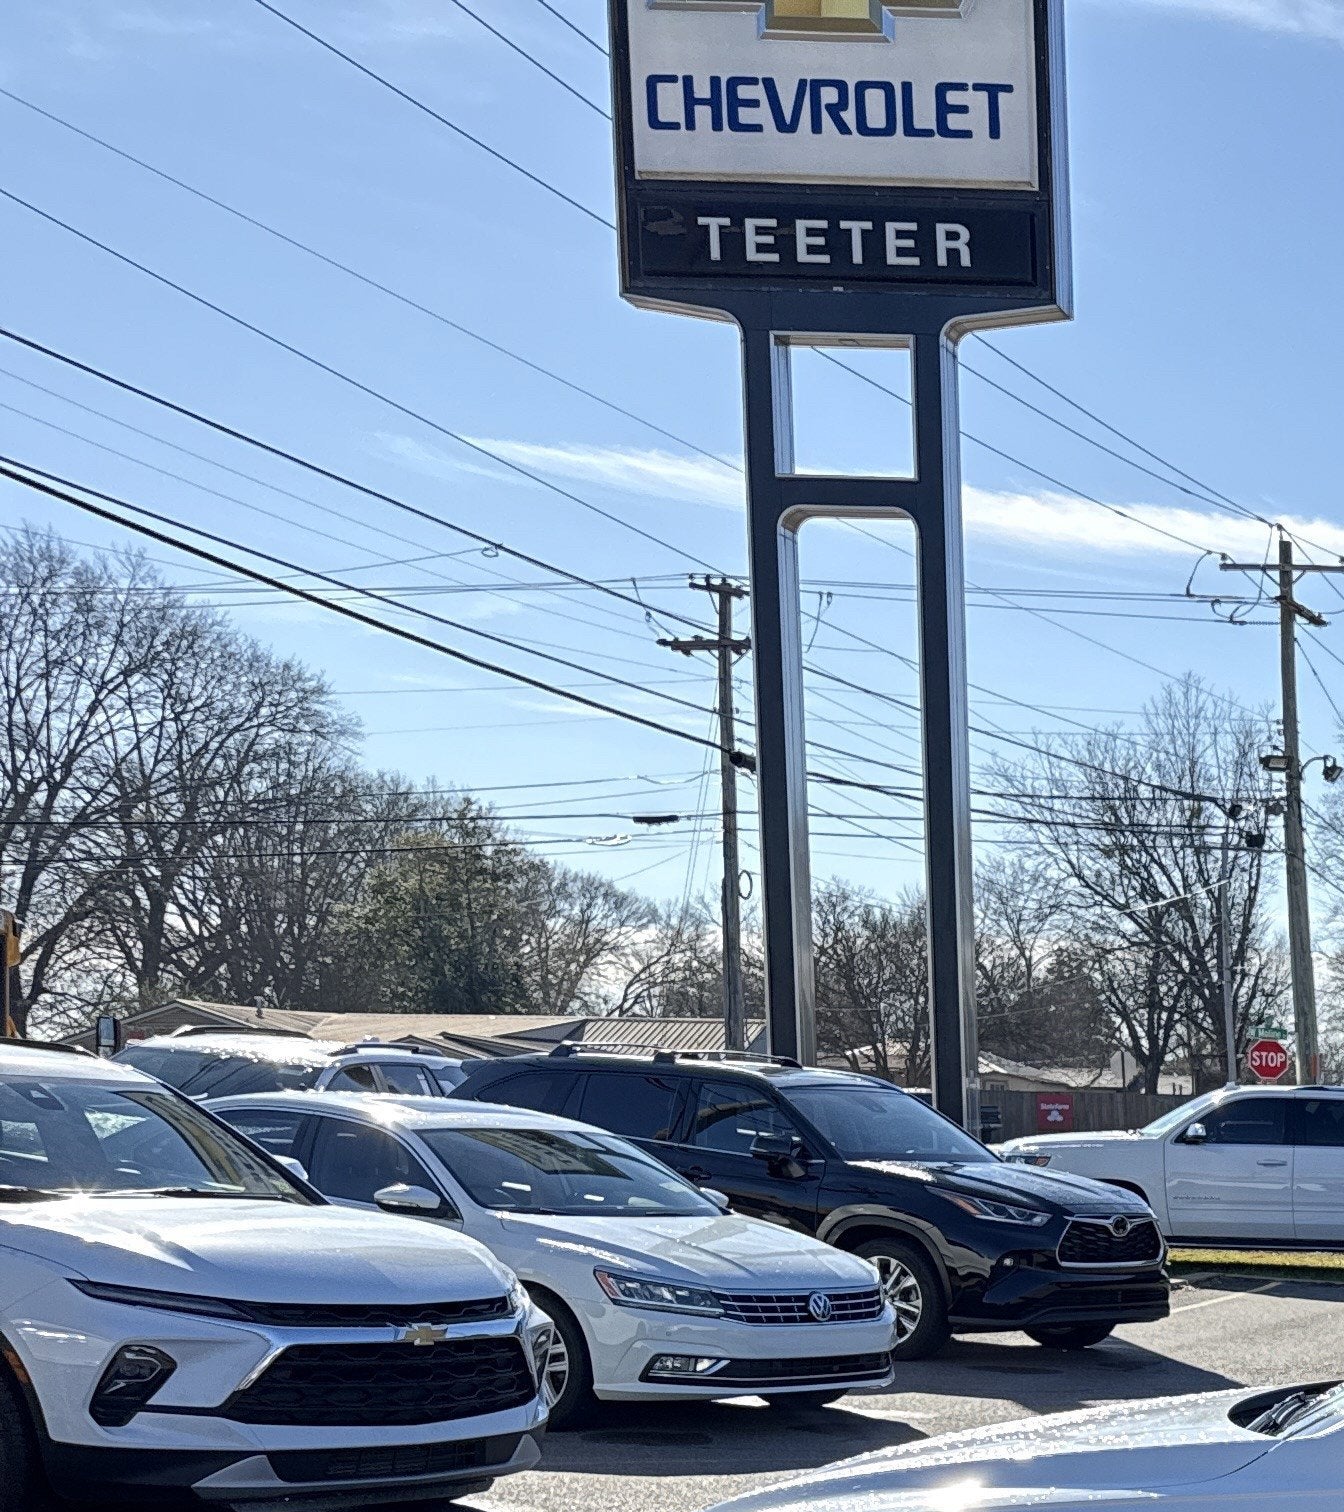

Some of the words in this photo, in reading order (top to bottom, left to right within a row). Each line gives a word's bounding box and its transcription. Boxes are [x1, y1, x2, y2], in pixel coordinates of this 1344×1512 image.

[645, 73, 1014, 140] CHEVROLET
[697, 216, 972, 268] TEETER
[1251, 1051, 1286, 1068] STOP
